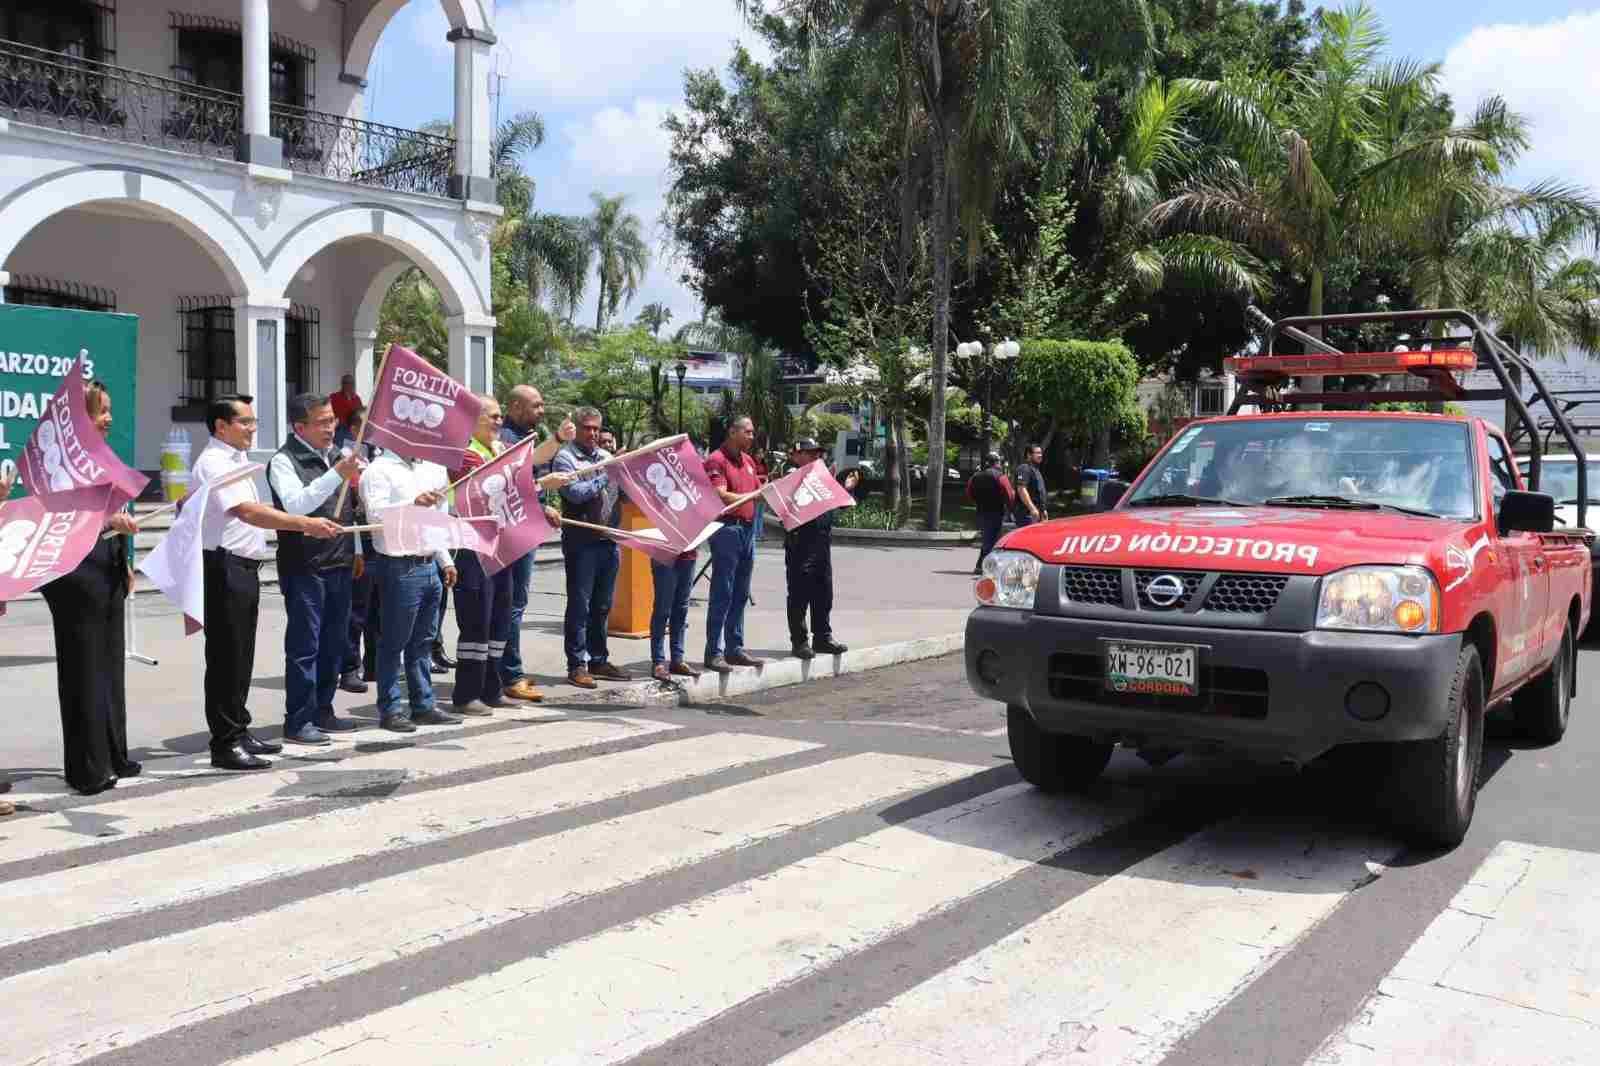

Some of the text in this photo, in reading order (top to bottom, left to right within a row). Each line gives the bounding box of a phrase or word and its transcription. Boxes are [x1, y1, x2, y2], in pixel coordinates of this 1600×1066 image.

[50, 357, 95, 380] 203
[57, 388, 105, 480] FORTÍN
[1109, 653, 1192, 678] XW-96-021
